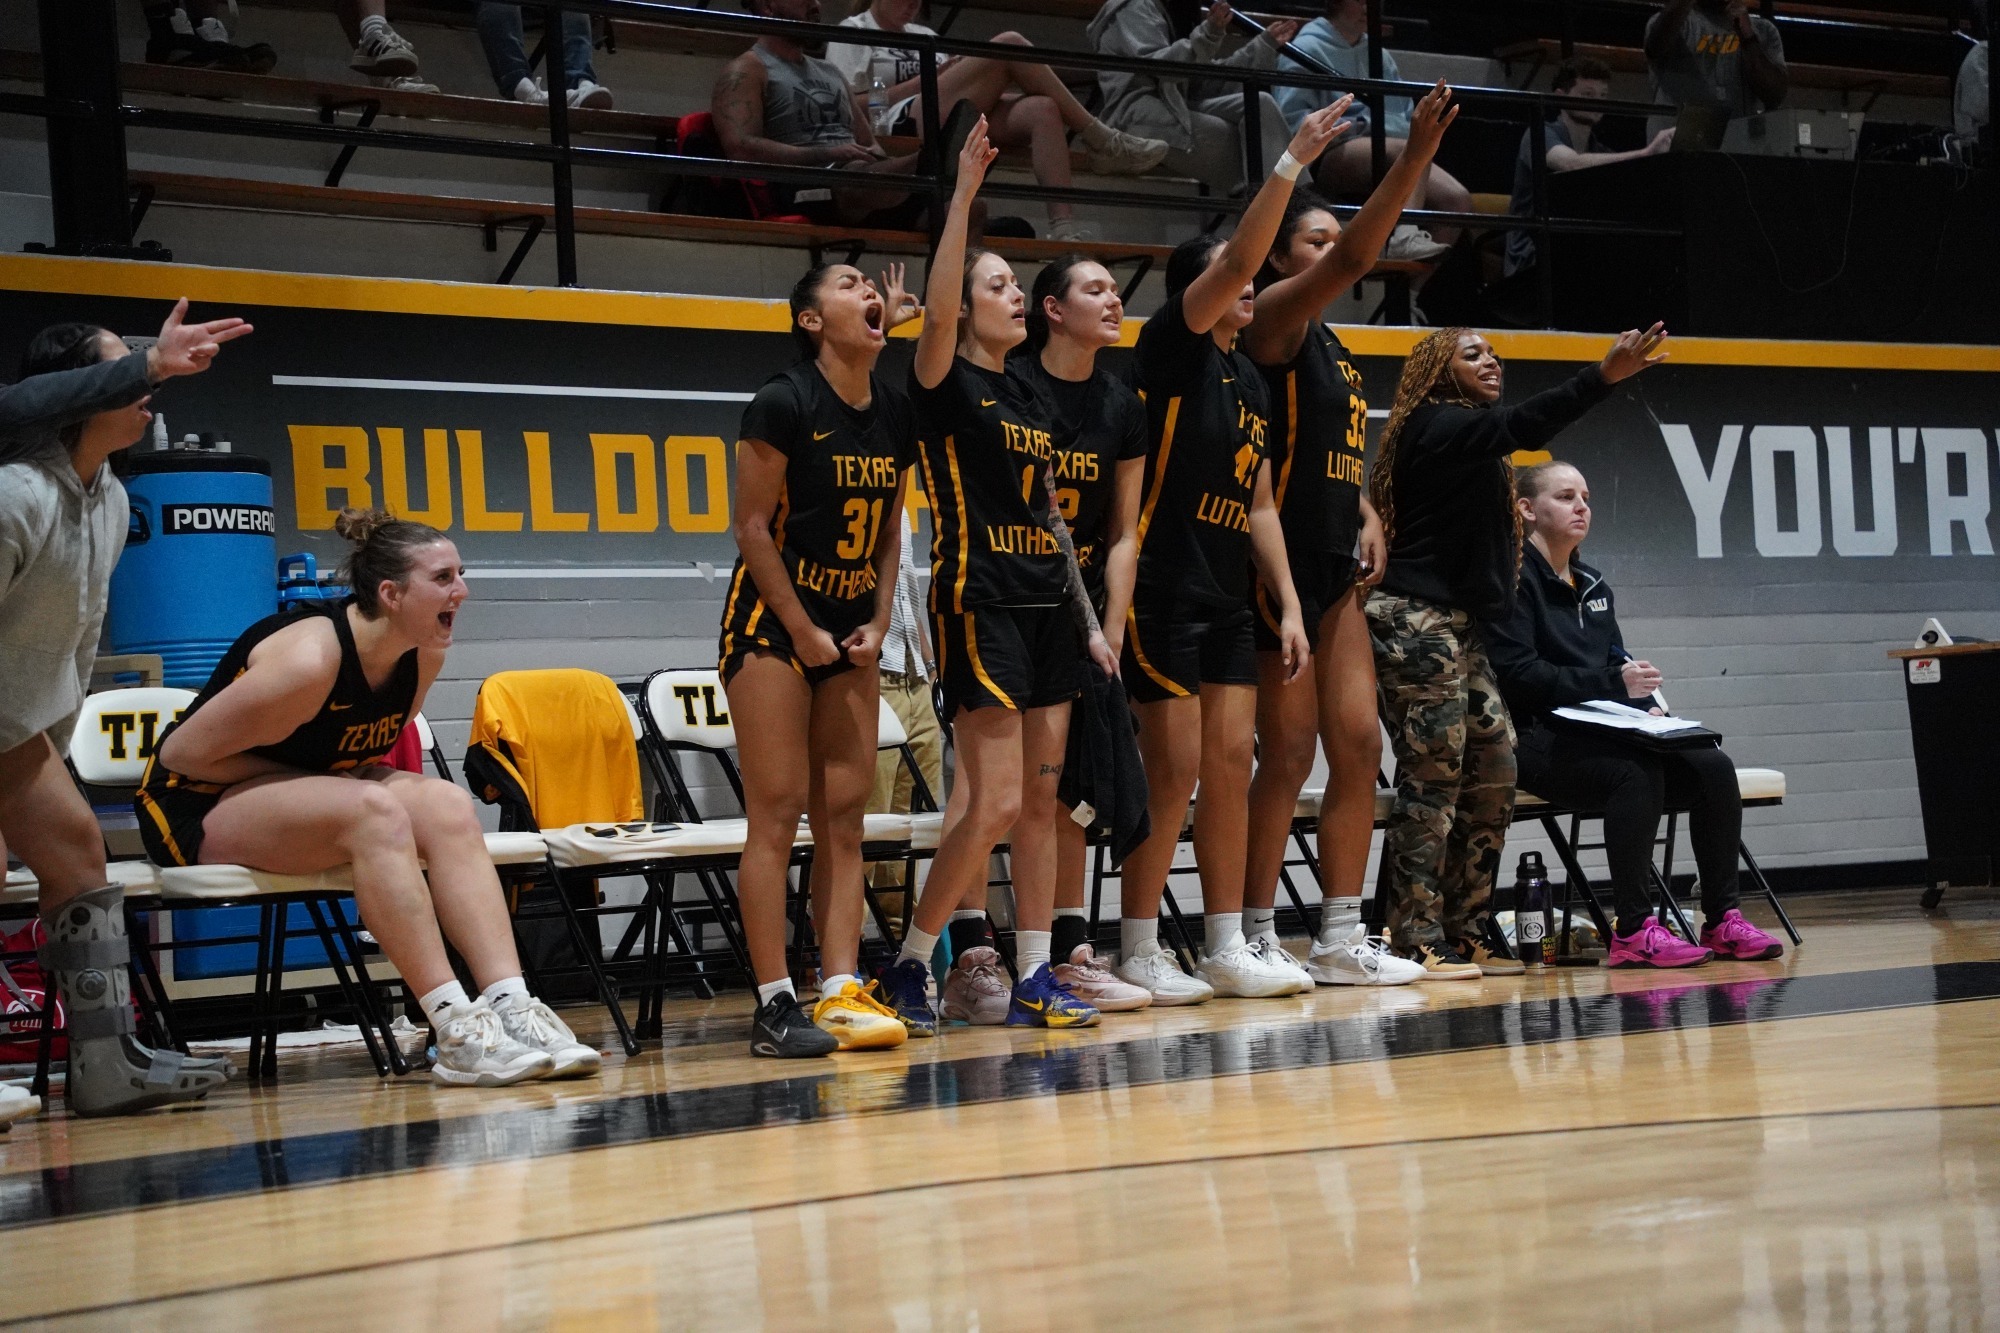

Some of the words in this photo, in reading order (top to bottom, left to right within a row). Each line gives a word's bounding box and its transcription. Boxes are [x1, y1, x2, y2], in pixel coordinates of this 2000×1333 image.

[1001, 420, 1052, 461] TEXAS
[1346, 394, 1367, 452] 33
[287, 425, 741, 533] BULLDO
[832, 455, 897, 488] TEXAS
[1022, 464, 1035, 505] 1
[1052, 450, 1098, 482] XAS
[1659, 423, 2000, 558] YOU'R
[837, 498, 883, 559] 31
[1196, 492, 1250, 534] LUTH
[100, 710, 186, 759] TL
[338, 713, 404, 752] TEXAS
